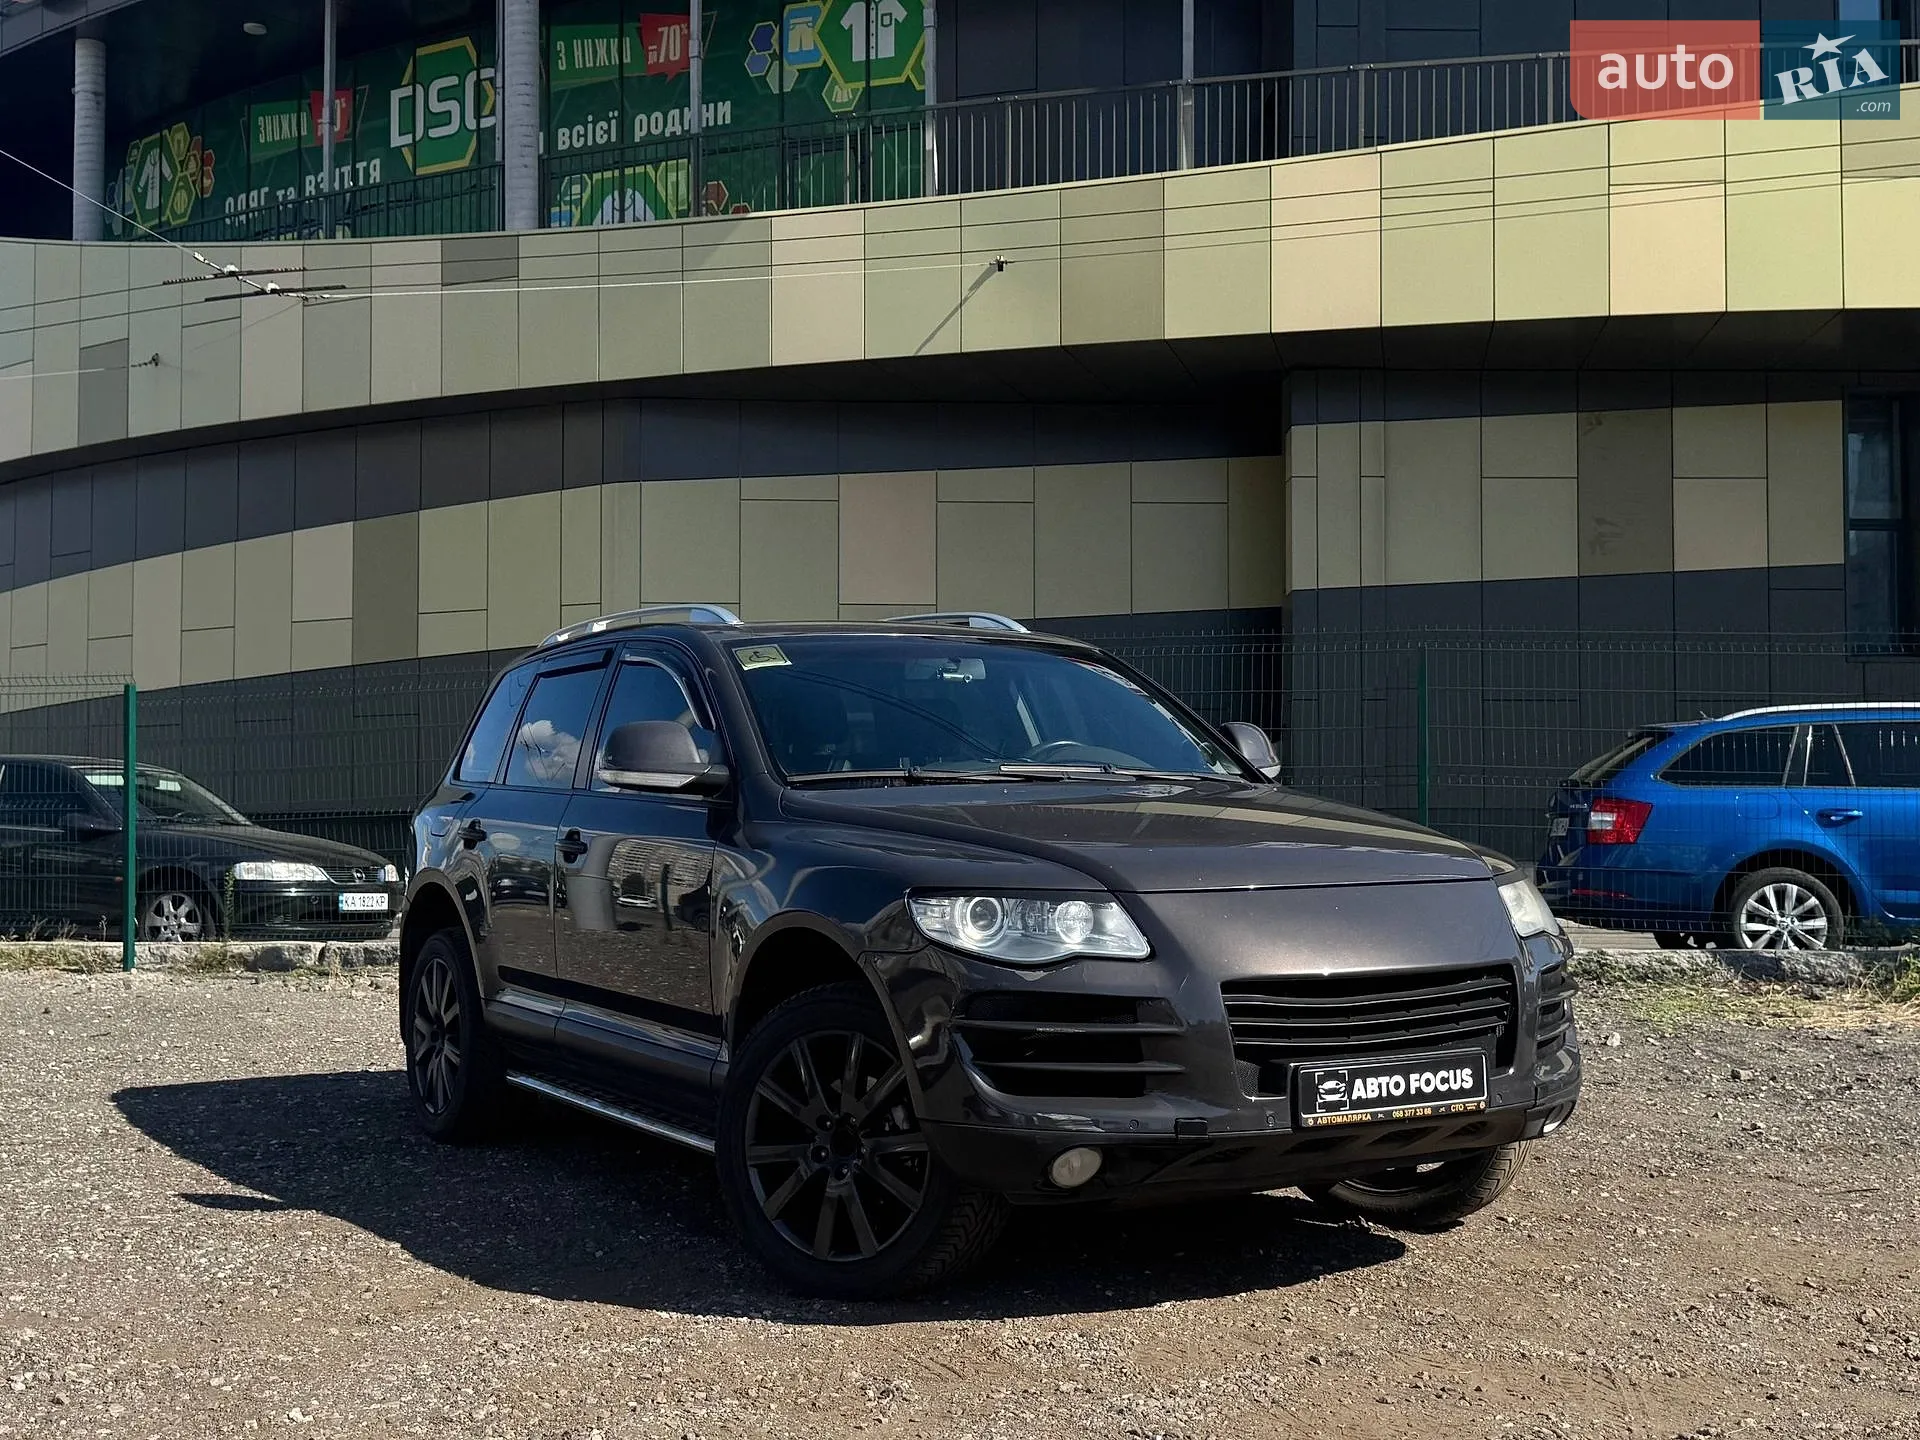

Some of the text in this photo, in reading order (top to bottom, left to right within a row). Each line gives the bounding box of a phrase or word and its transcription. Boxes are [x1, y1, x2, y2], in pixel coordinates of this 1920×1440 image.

[390, 67, 497, 148] DSC
[258, 111, 308, 143] ЗНИЖКИ
[557, 110, 619, 151] всієї
[634, 100, 731, 142] родини
[1351, 1068, 1474, 1100] АВТО FOCUS
[1317, 1112, 1372, 1125] АВТОМАЛЯРКА
[1404, 1108, 1415, 1117] 377
[1450, 1103, 1464, 1112] СТО
